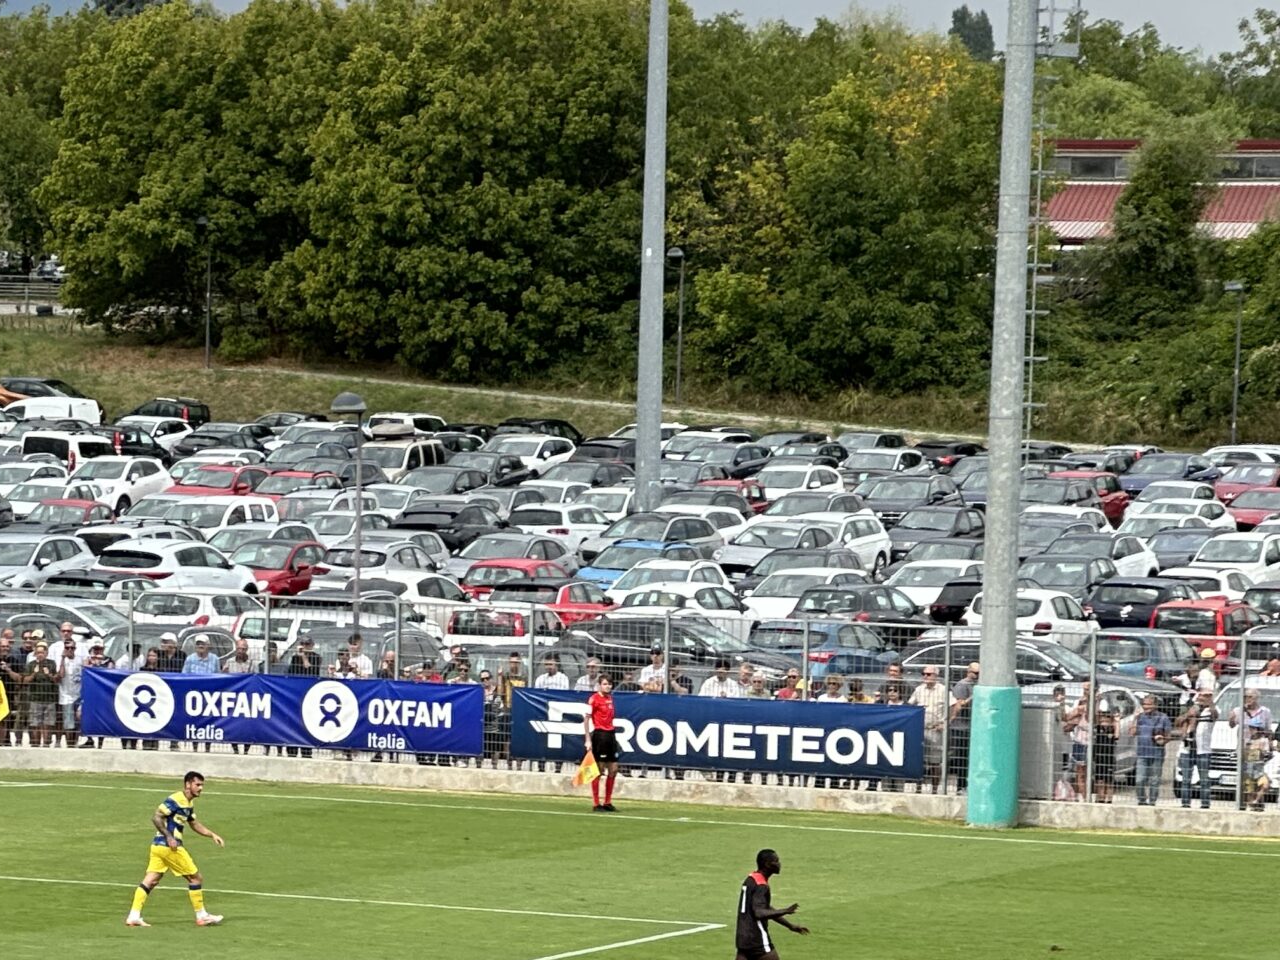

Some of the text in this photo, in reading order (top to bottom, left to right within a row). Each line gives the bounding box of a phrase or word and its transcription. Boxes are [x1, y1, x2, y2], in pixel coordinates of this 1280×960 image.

[185, 690, 272, 719] OXFAM
[368, 699, 452, 728] OXFAM
[185, 724, 224, 741] Italia
[368, 733, 406, 750] Italia
